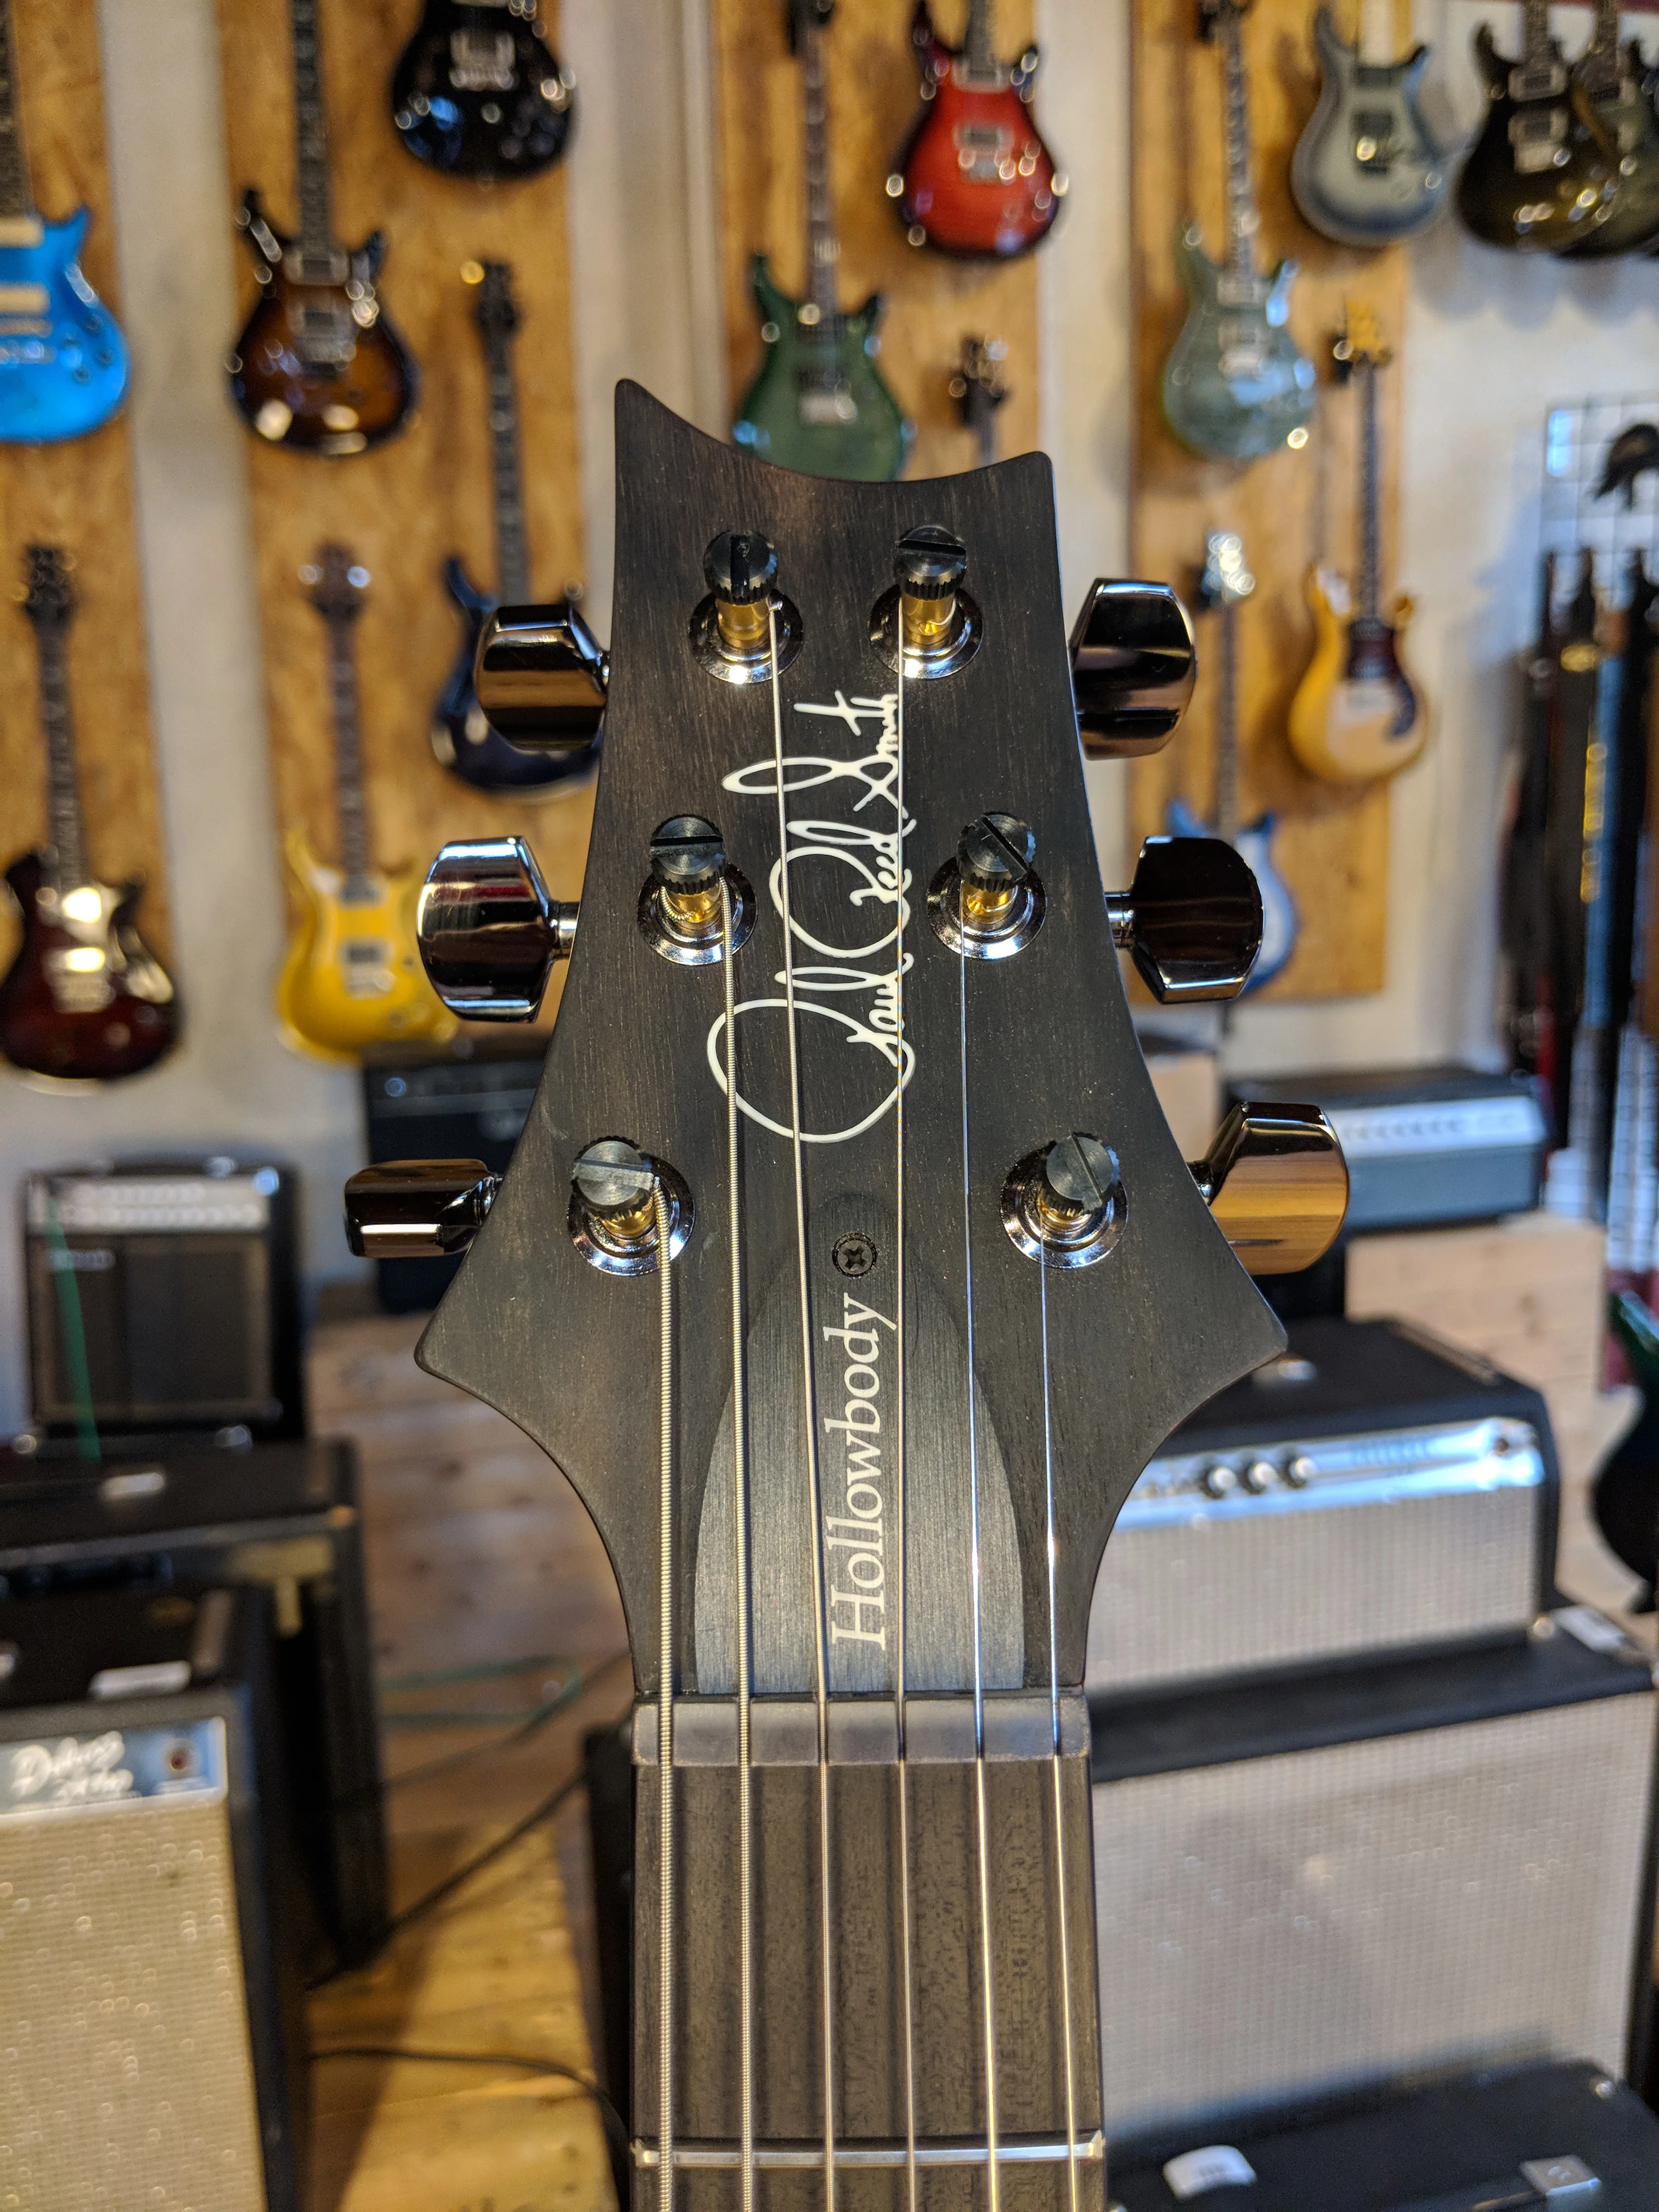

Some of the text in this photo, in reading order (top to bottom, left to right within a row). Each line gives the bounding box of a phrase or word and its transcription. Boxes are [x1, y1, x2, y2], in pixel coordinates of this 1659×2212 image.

[708, 691, 916, 1143] Paul Reed Smith
[823, 1294, 897, 1650] Hollowbody
